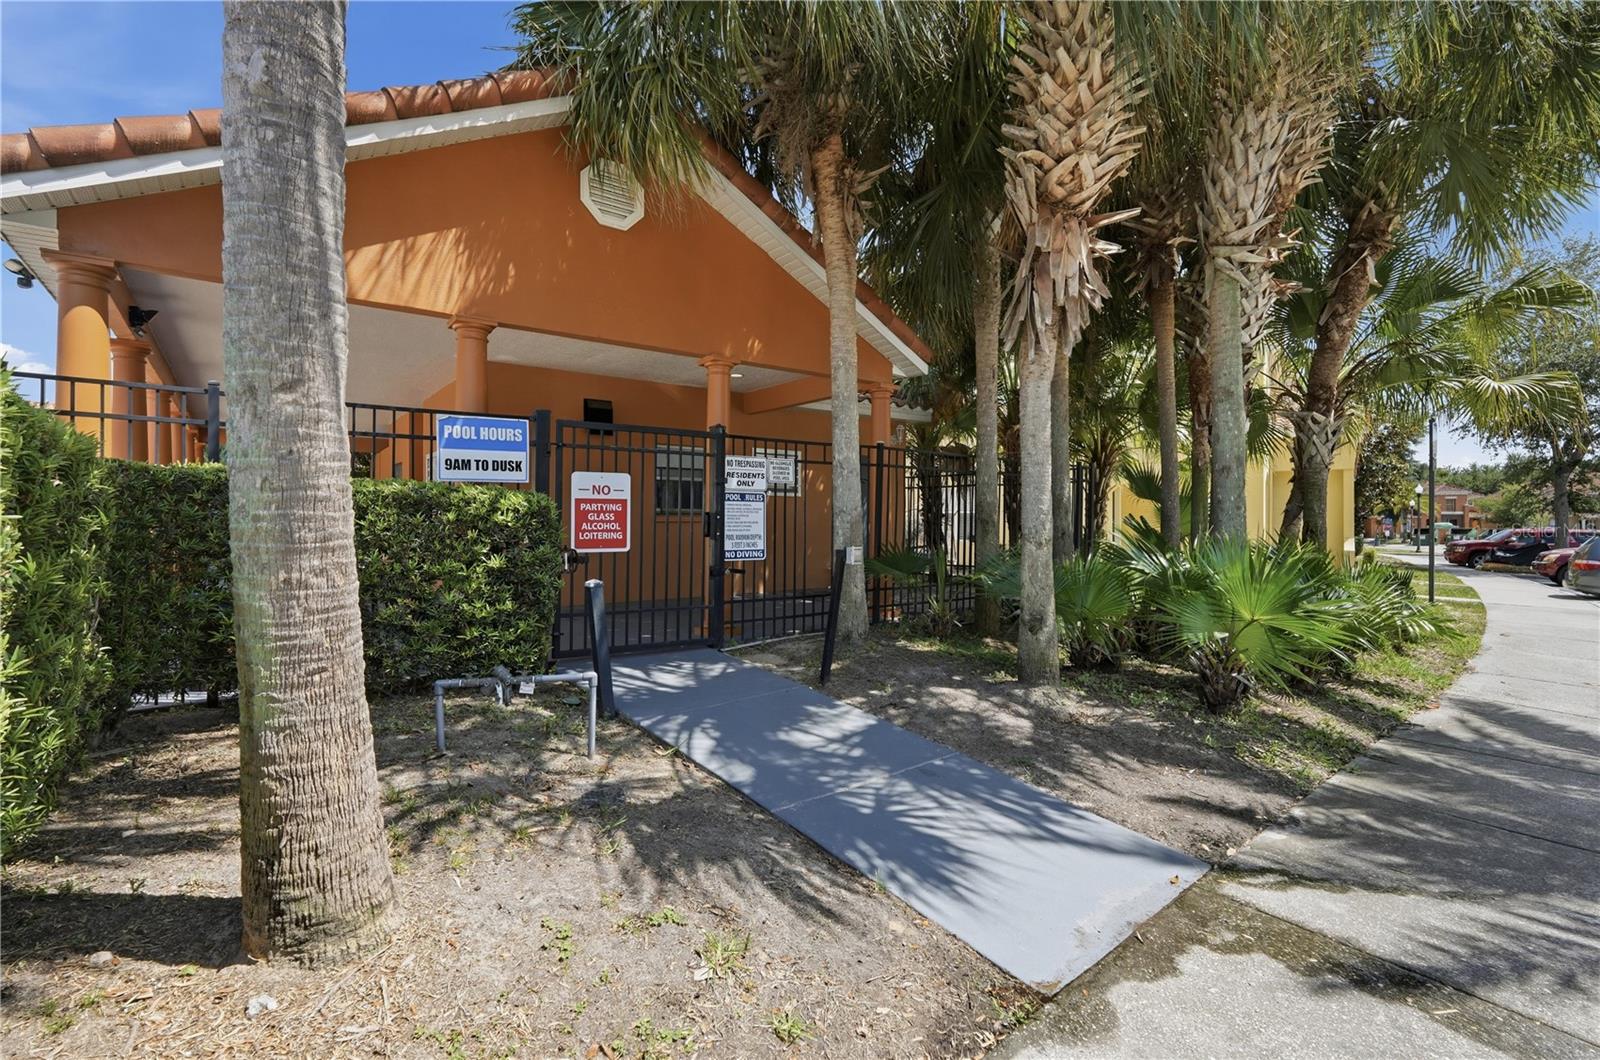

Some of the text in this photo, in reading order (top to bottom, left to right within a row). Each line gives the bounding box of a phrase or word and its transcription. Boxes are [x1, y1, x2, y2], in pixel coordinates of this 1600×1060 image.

[443, 424, 522, 442] POOL HOURS
[445, 457, 523, 473] 9AM TO DUSK
[735, 460, 765, 468] TRESPASSING
[592, 484, 611, 496] NO
[580, 503, 622, 511] PARTYING
[588, 512, 615, 521] GLASS
[581, 522, 621, 530] ALCOHOL
[579, 532, 623, 540] LOITERING
